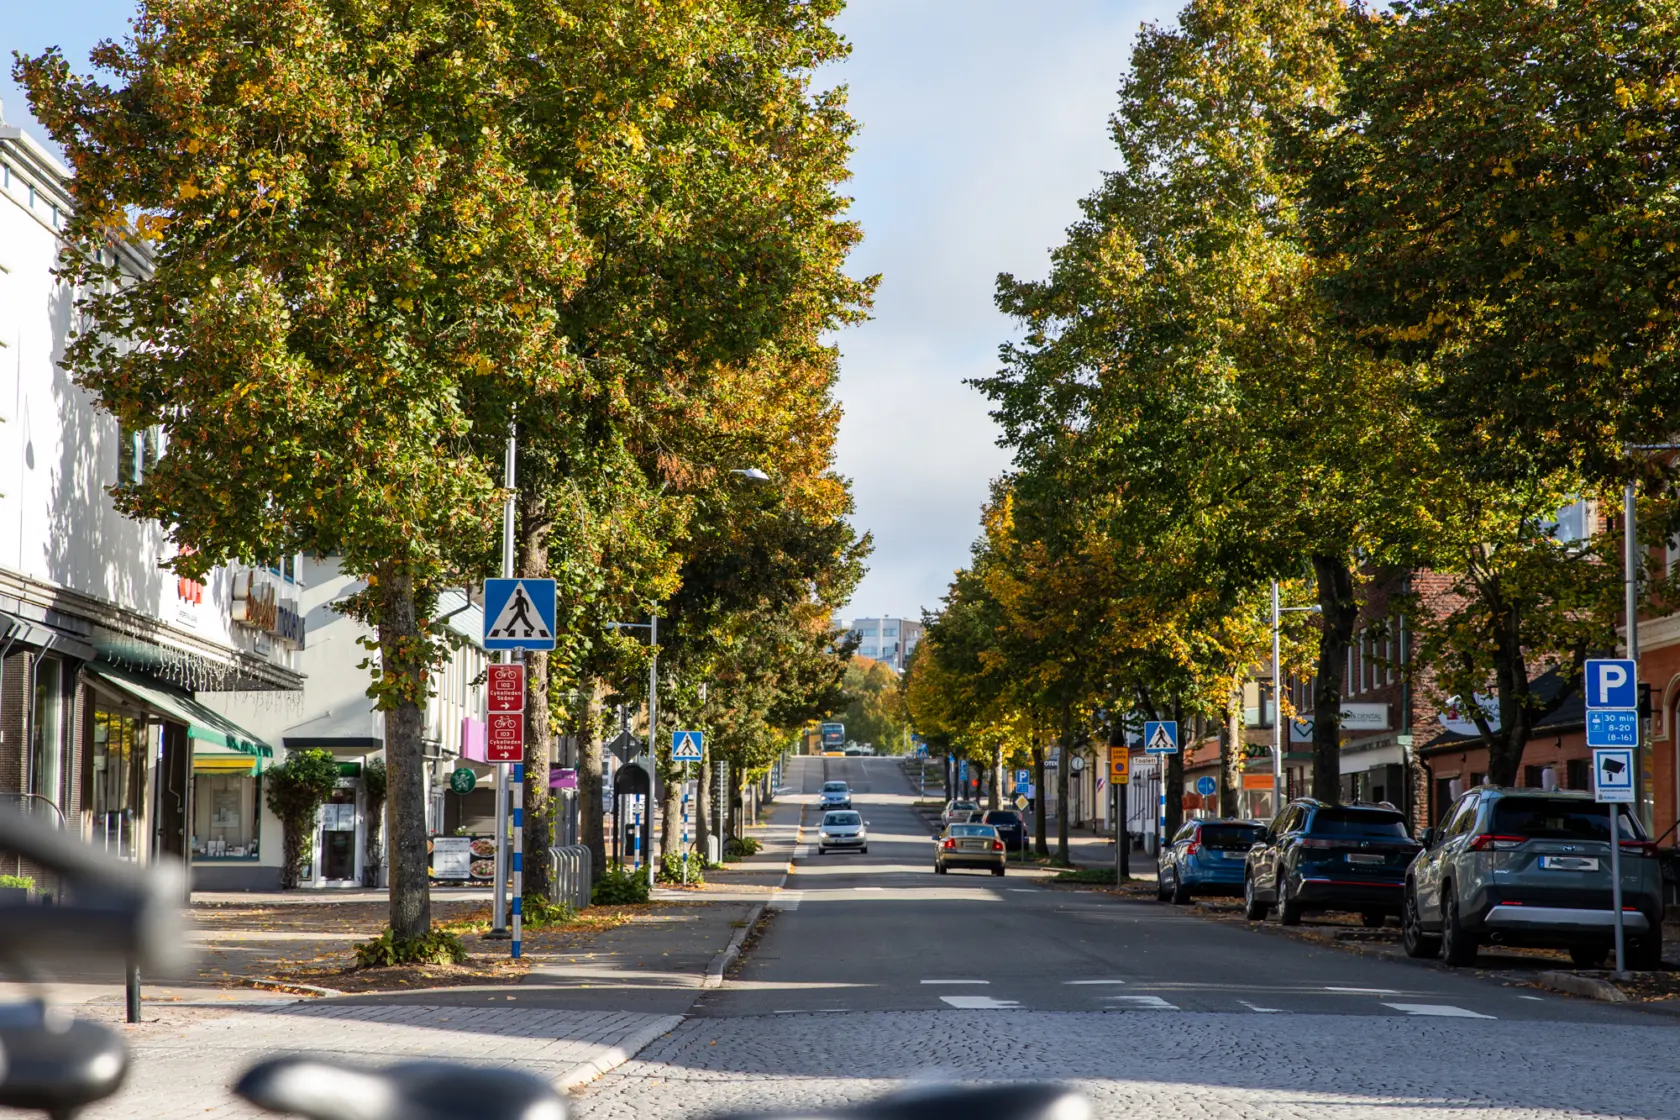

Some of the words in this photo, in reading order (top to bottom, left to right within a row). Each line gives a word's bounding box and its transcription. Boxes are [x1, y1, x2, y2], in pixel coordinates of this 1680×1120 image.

[1599, 664, 1627, 703] P
[1604, 714, 1616, 722] 30
[1619, 714, 1635, 722] min
[1608, 724, 1631, 732] 8-20
[1607, 733, 1633, 741] (8-16)
[1019, 771, 1027, 782] P
